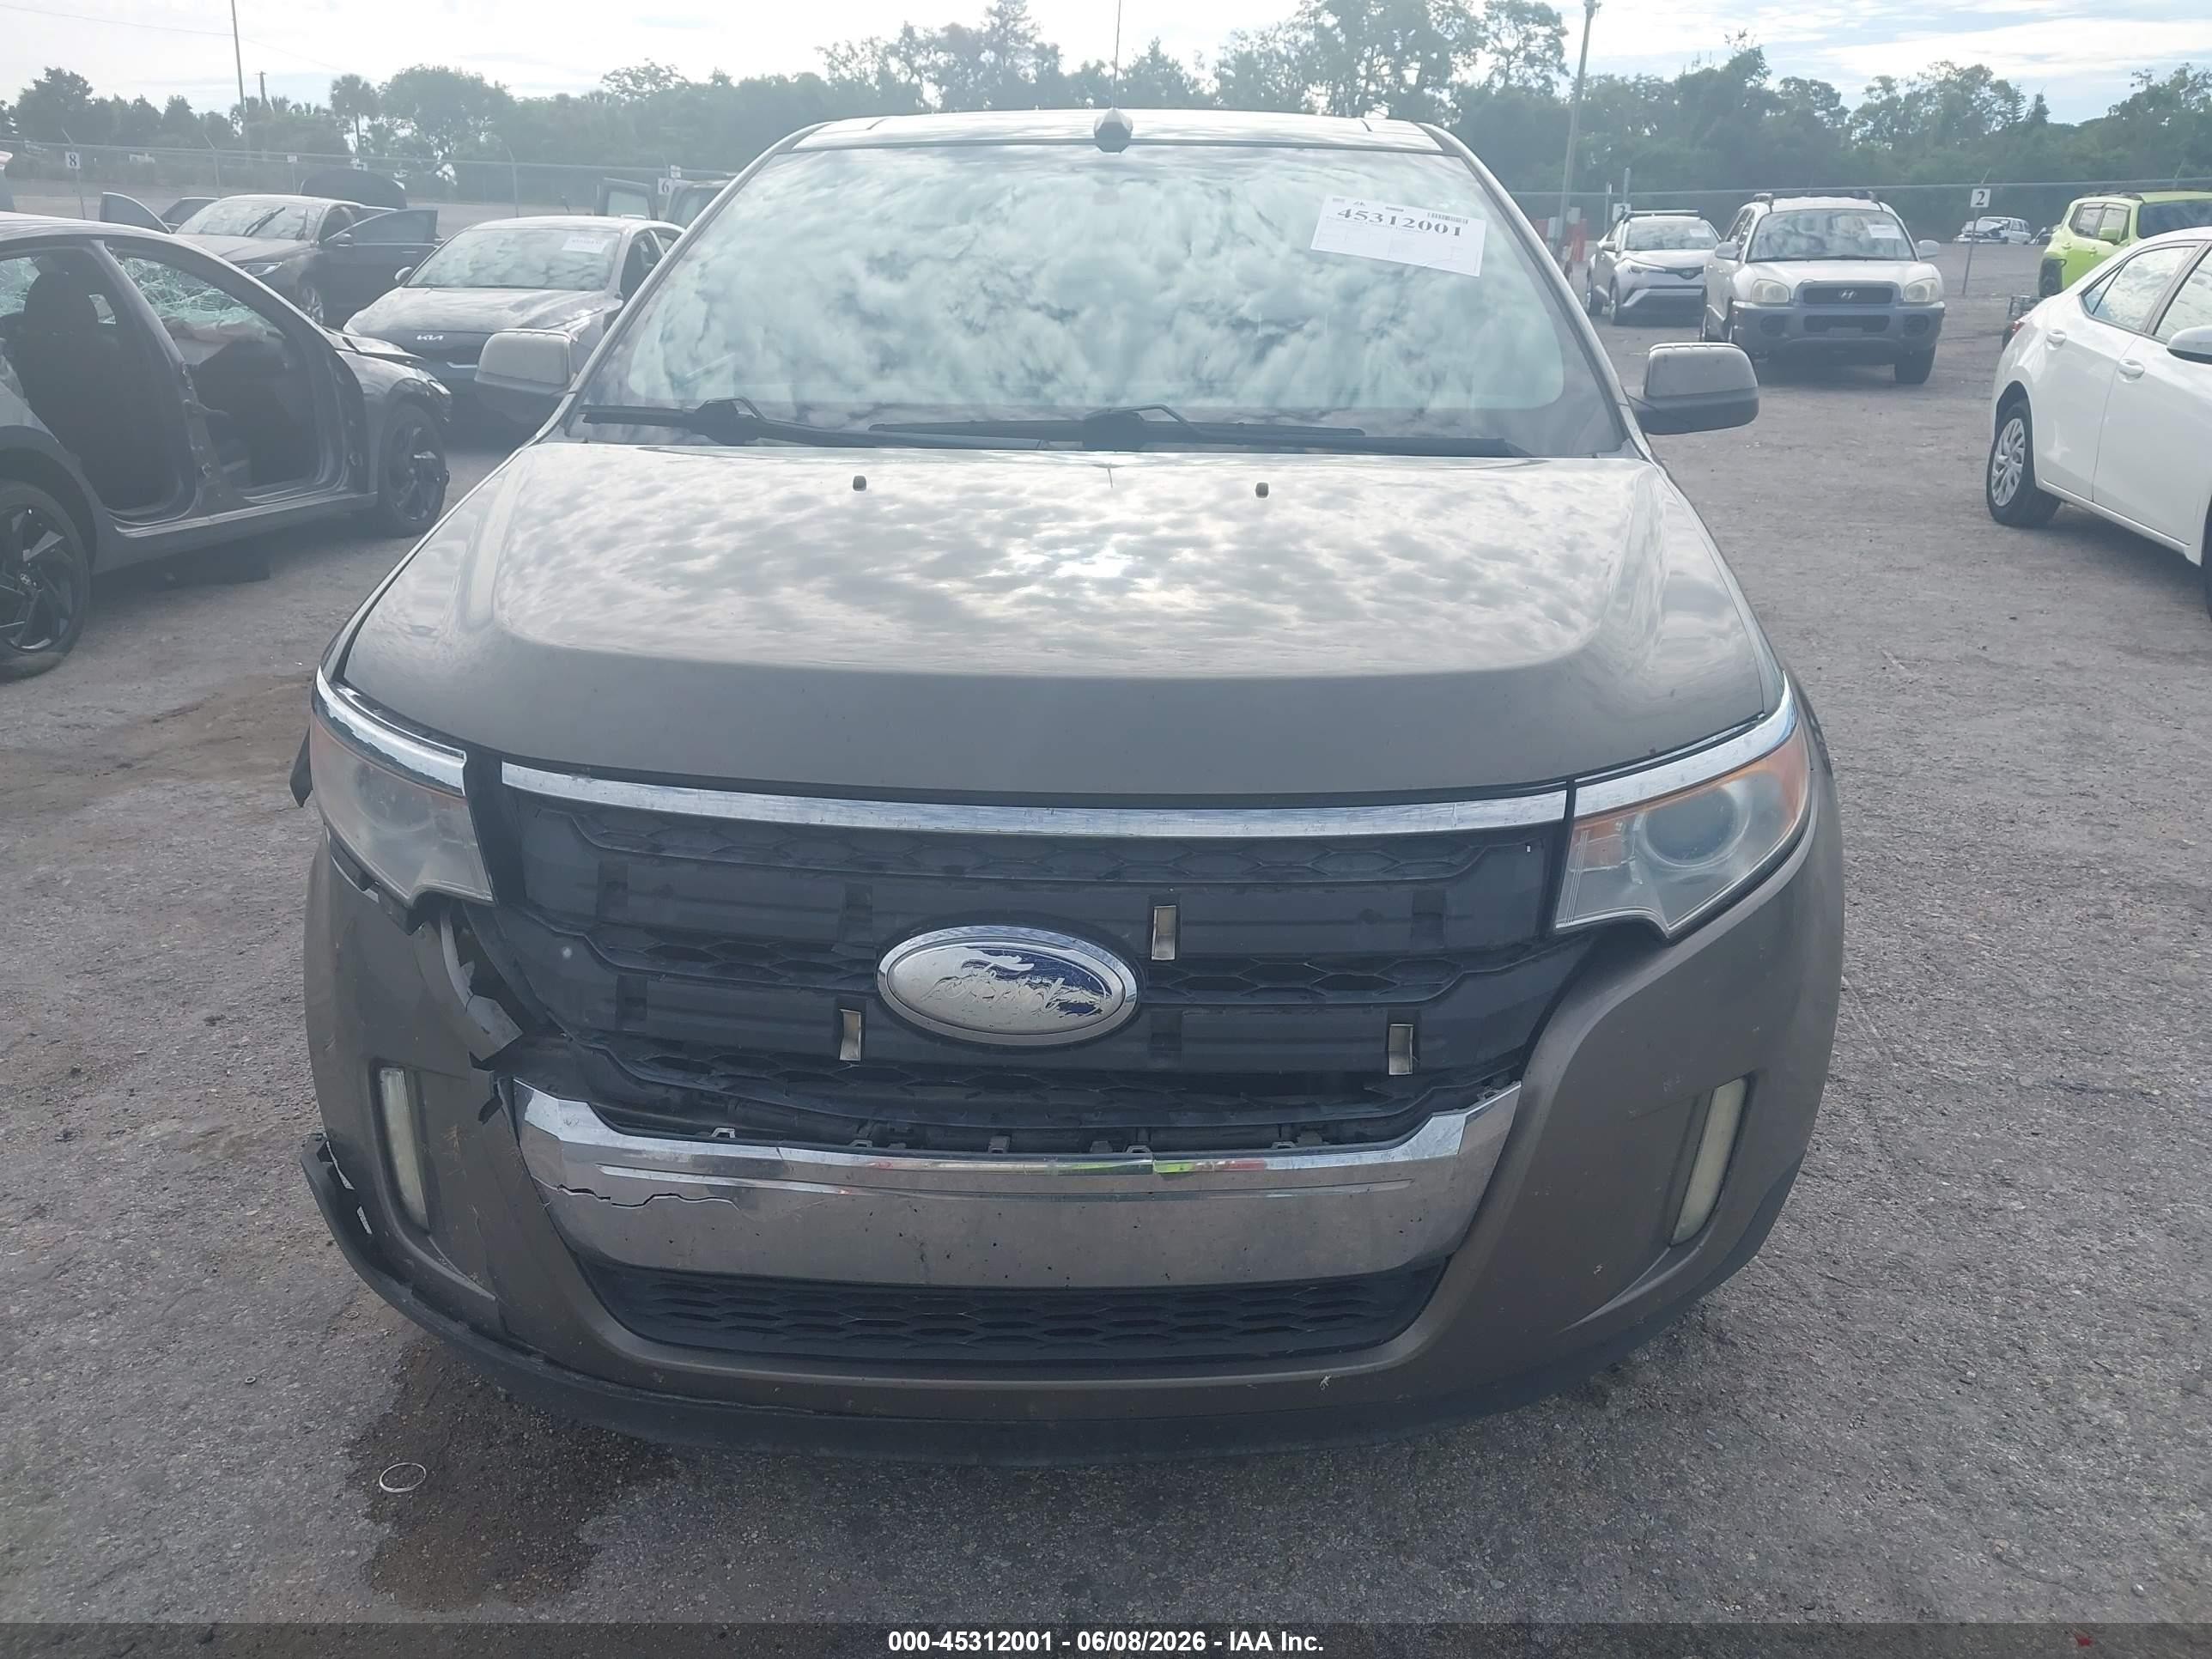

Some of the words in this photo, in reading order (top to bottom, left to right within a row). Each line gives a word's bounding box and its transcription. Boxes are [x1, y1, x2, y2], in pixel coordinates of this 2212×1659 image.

[69, 154, 77, 167] 8
[661, 179, 670, 193] 6
[1975, 191, 1985, 206] 2
[1337, 208, 1462, 237] 45312001
